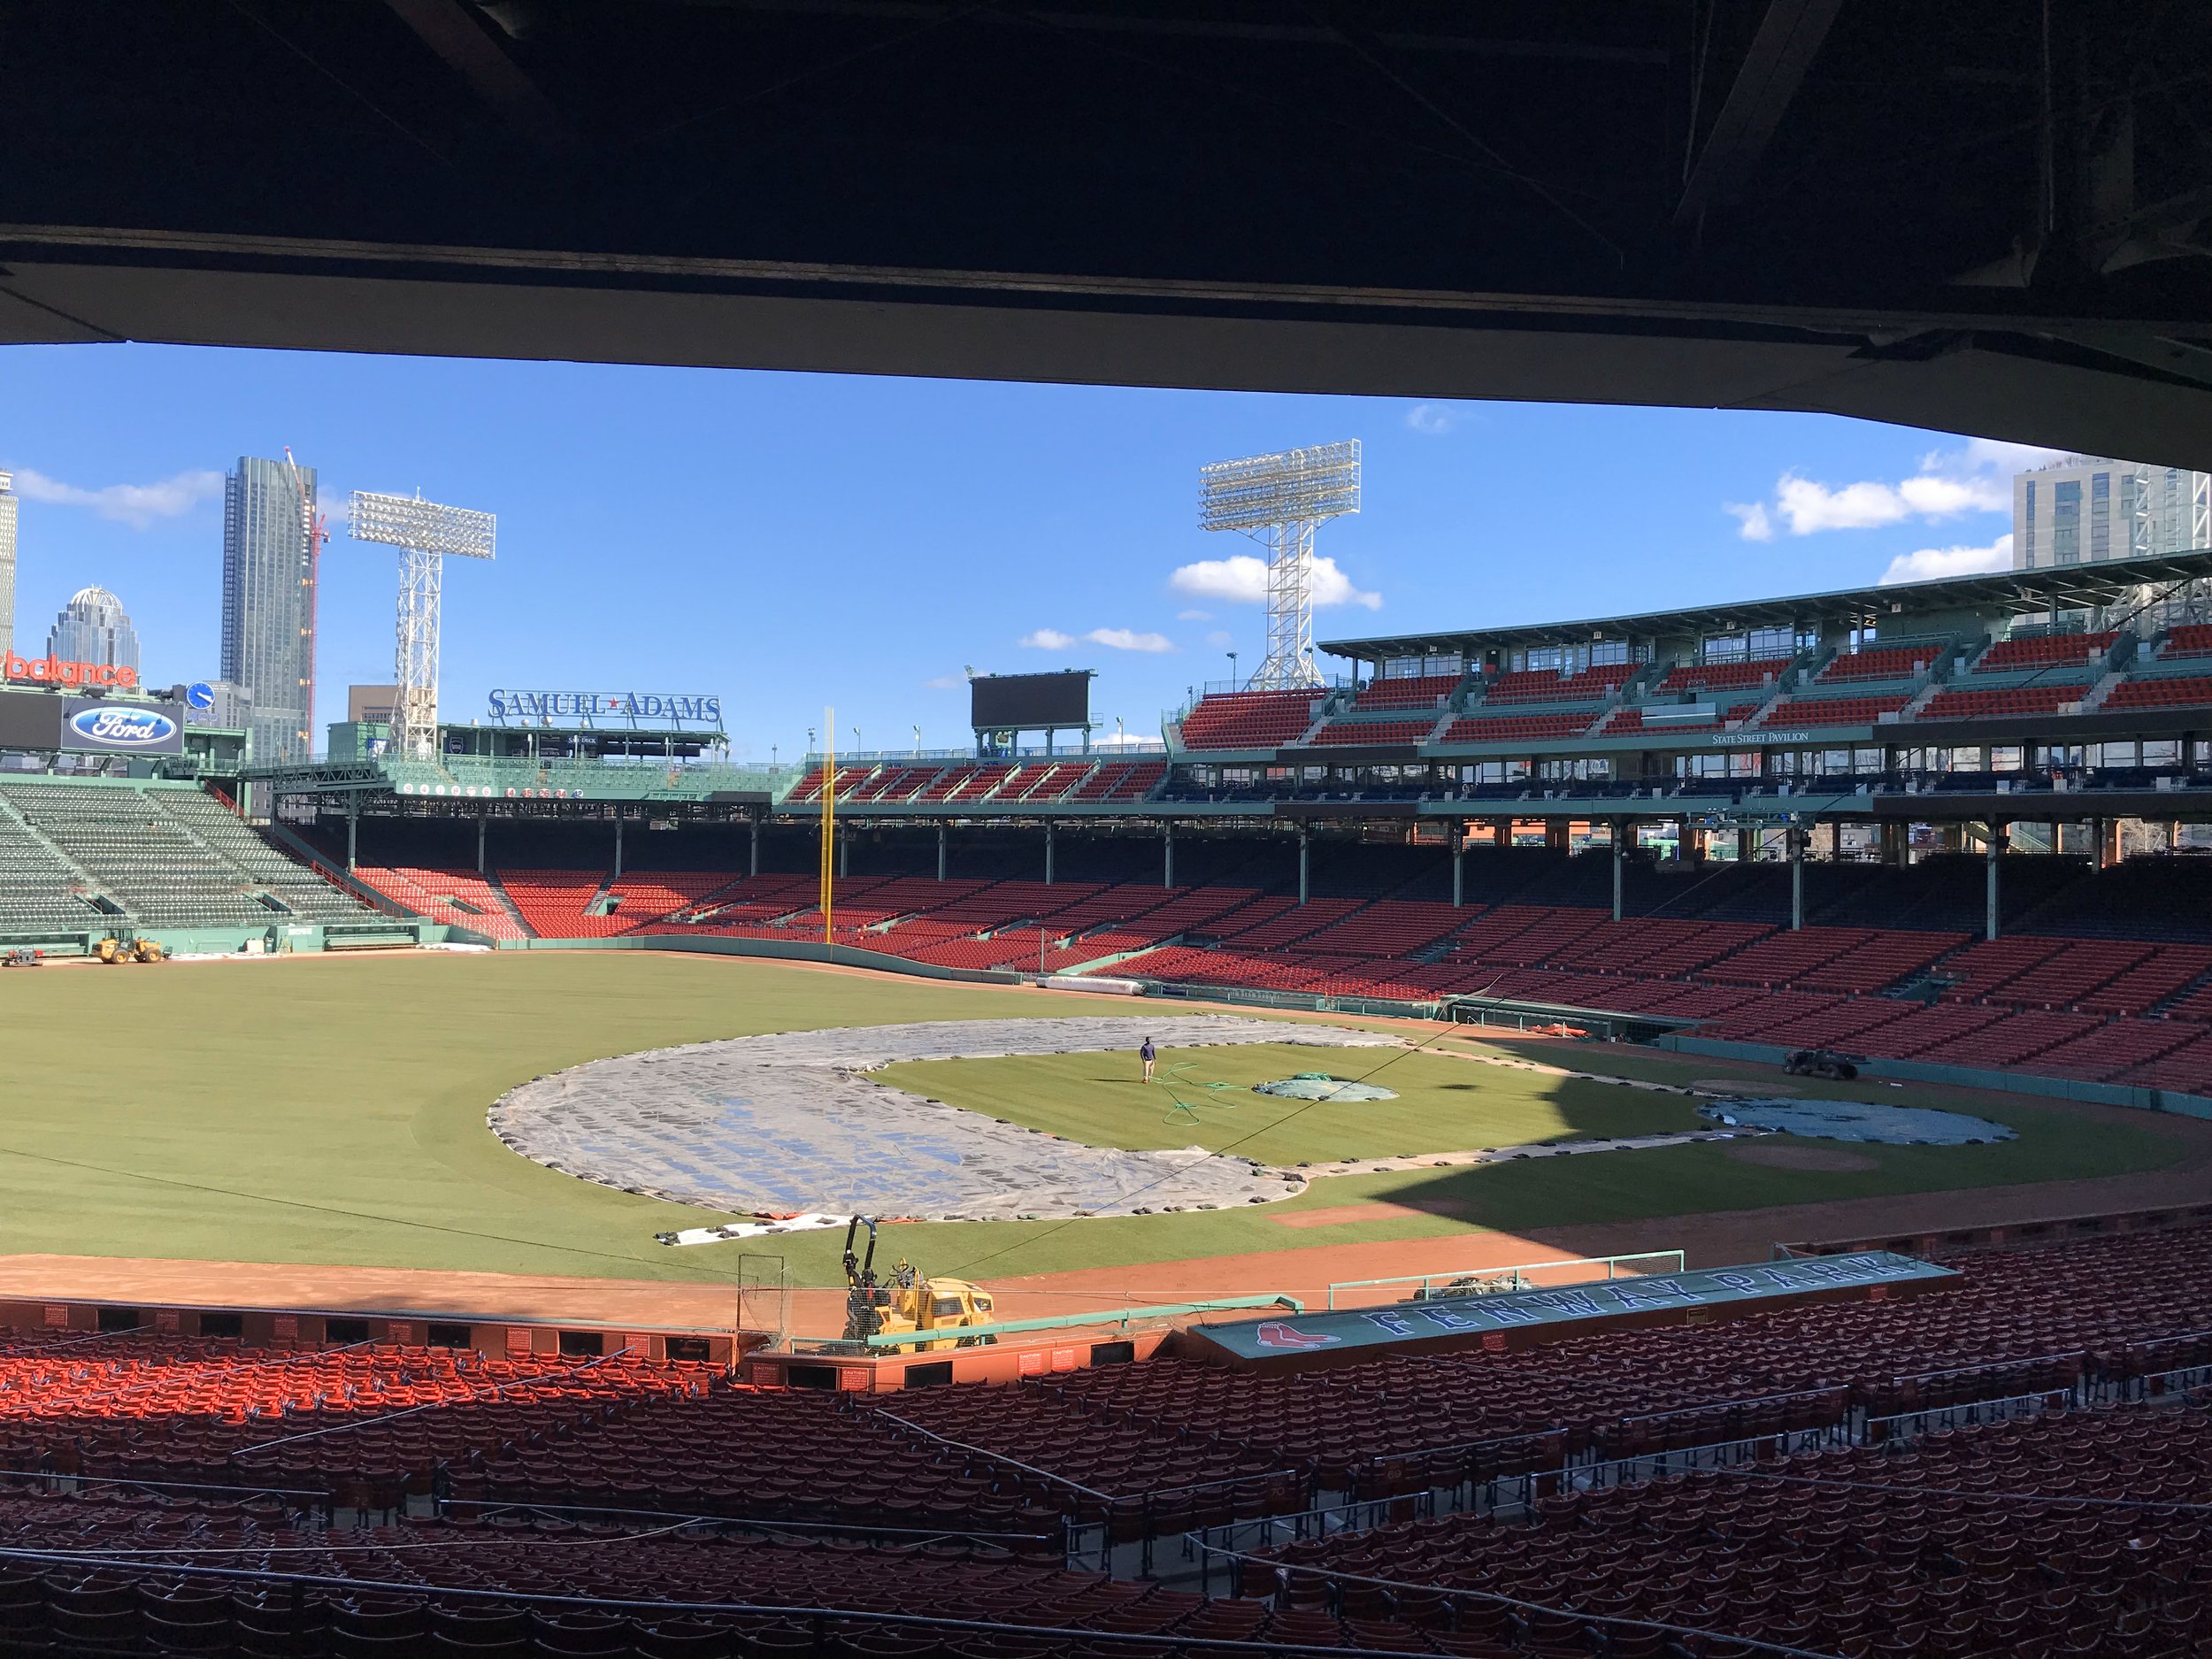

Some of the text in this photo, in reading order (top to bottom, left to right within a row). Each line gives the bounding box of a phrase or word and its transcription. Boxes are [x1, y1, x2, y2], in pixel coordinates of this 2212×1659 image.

[5, 650, 137, 688] balance
[488, 688, 722, 723] SAMUEL ADAMS
[92, 711, 155, 739] Ford
[1712, 732, 1809, 744] STATE STREET PAVILION
[1358, 1255, 1916, 1335] FENWAY PARK
